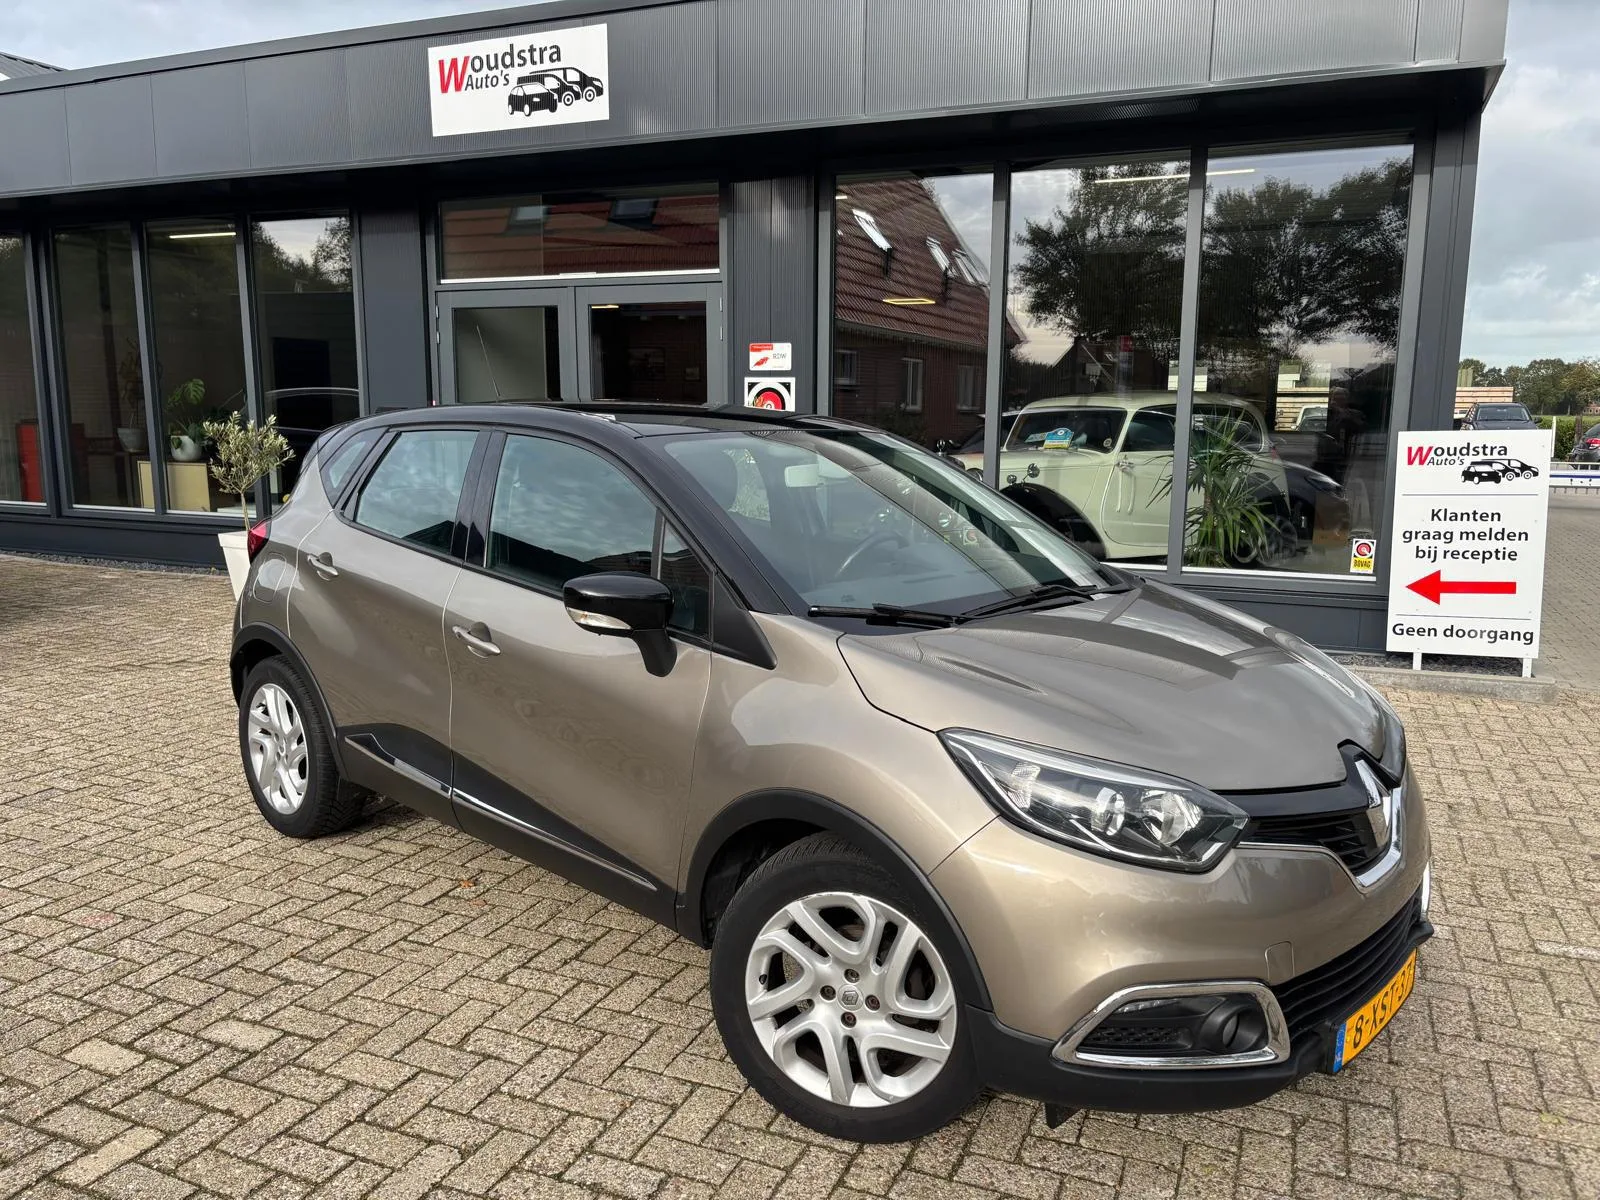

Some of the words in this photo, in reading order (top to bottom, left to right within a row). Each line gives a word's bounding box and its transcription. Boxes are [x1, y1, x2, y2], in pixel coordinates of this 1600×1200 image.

[438, 43, 562, 94] Woudstra
[465, 70, 510, 91] Auto's
[1407, 442, 1508, 466] Woudstra
[1427, 456, 1465, 466] Auto's
[1430, 508, 1502, 522] Klanten
[1402, 529, 1454, 544] graag
[1459, 527, 1529, 542] melden
[1353, 559, 1371, 568] BOVAG
[1415, 545, 1438, 563] bij
[1442, 546, 1518, 564] receptie
[1392, 623, 1438, 637] Geen
[1443, 624, 1534, 646] doorgang
[1352, 960, 1413, 1049] 8-XST-37
